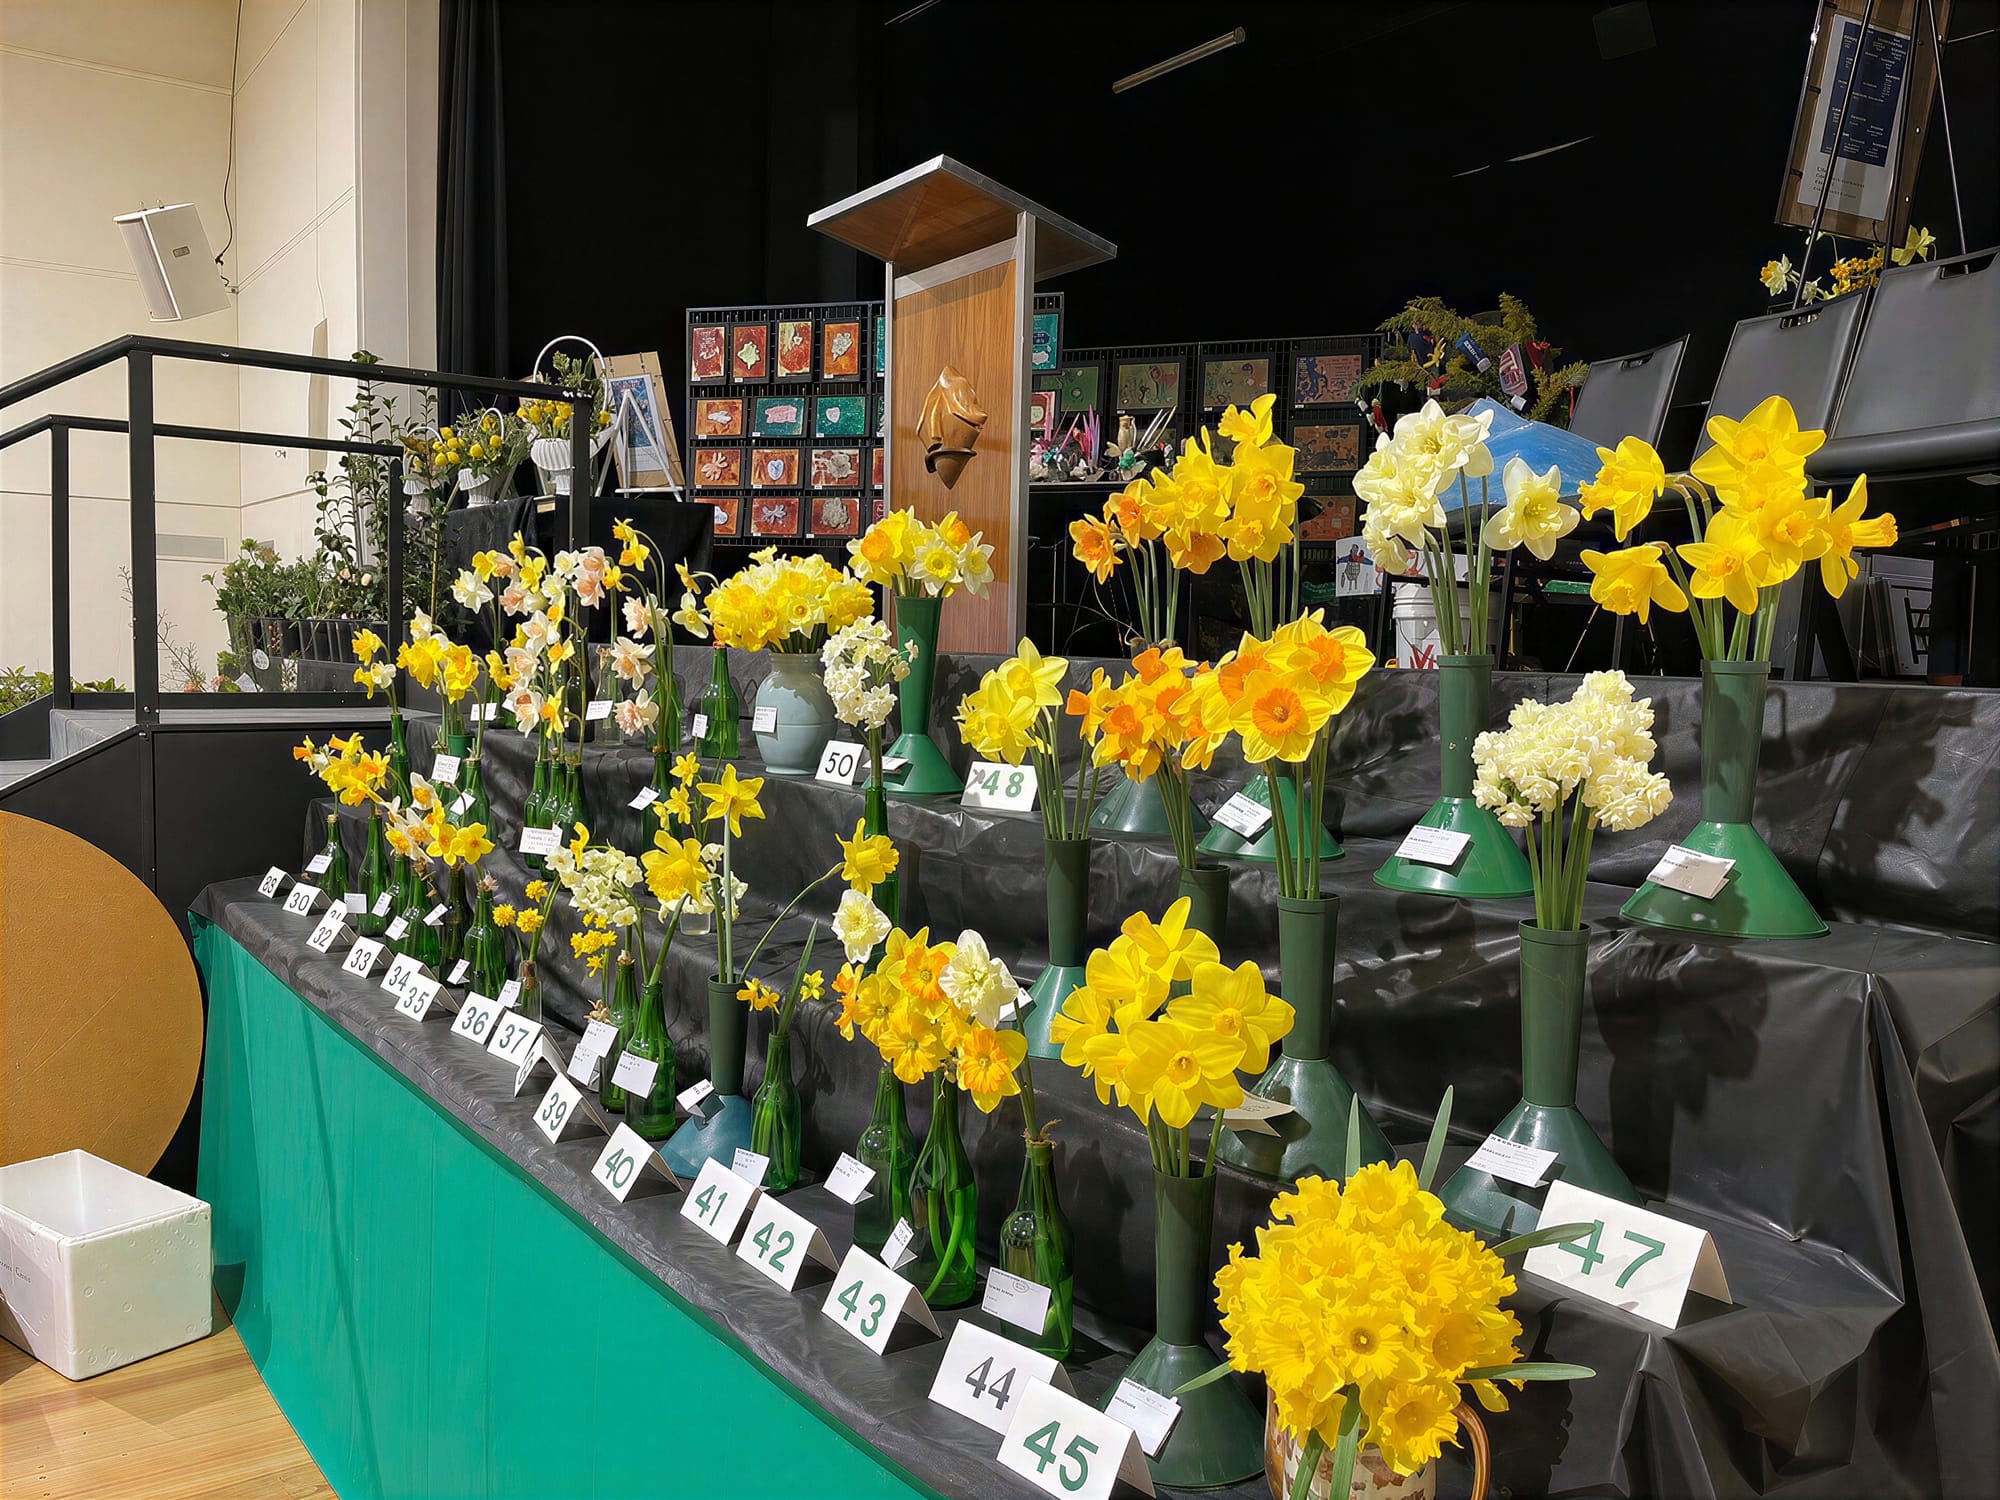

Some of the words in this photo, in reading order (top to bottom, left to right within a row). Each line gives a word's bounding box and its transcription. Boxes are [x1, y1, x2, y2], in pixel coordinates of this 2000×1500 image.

[825, 751, 852, 778] 50
[981, 769, 1025, 798] 48
[289, 892, 310, 911] 30
[313, 927, 332, 947] 32
[350, 949, 372, 971] 33
[389, 966, 411, 992] 34
[403, 987, 430, 1014] 35
[461, 1006, 490, 1035] 36
[499, 1024, 530, 1054] 37
[541, 1092, 568, 1131] 39
[605, 1148, 635, 1189] 40
[694, 1183, 728, 1227] 41
[752, 1221, 796, 1273] 42
[1558, 1219, 1666, 1289] 47
[837, 1279, 886, 1337] 43
[964, 1356, 1016, 1411] 44
[1023, 1420, 1099, 1492] 45
